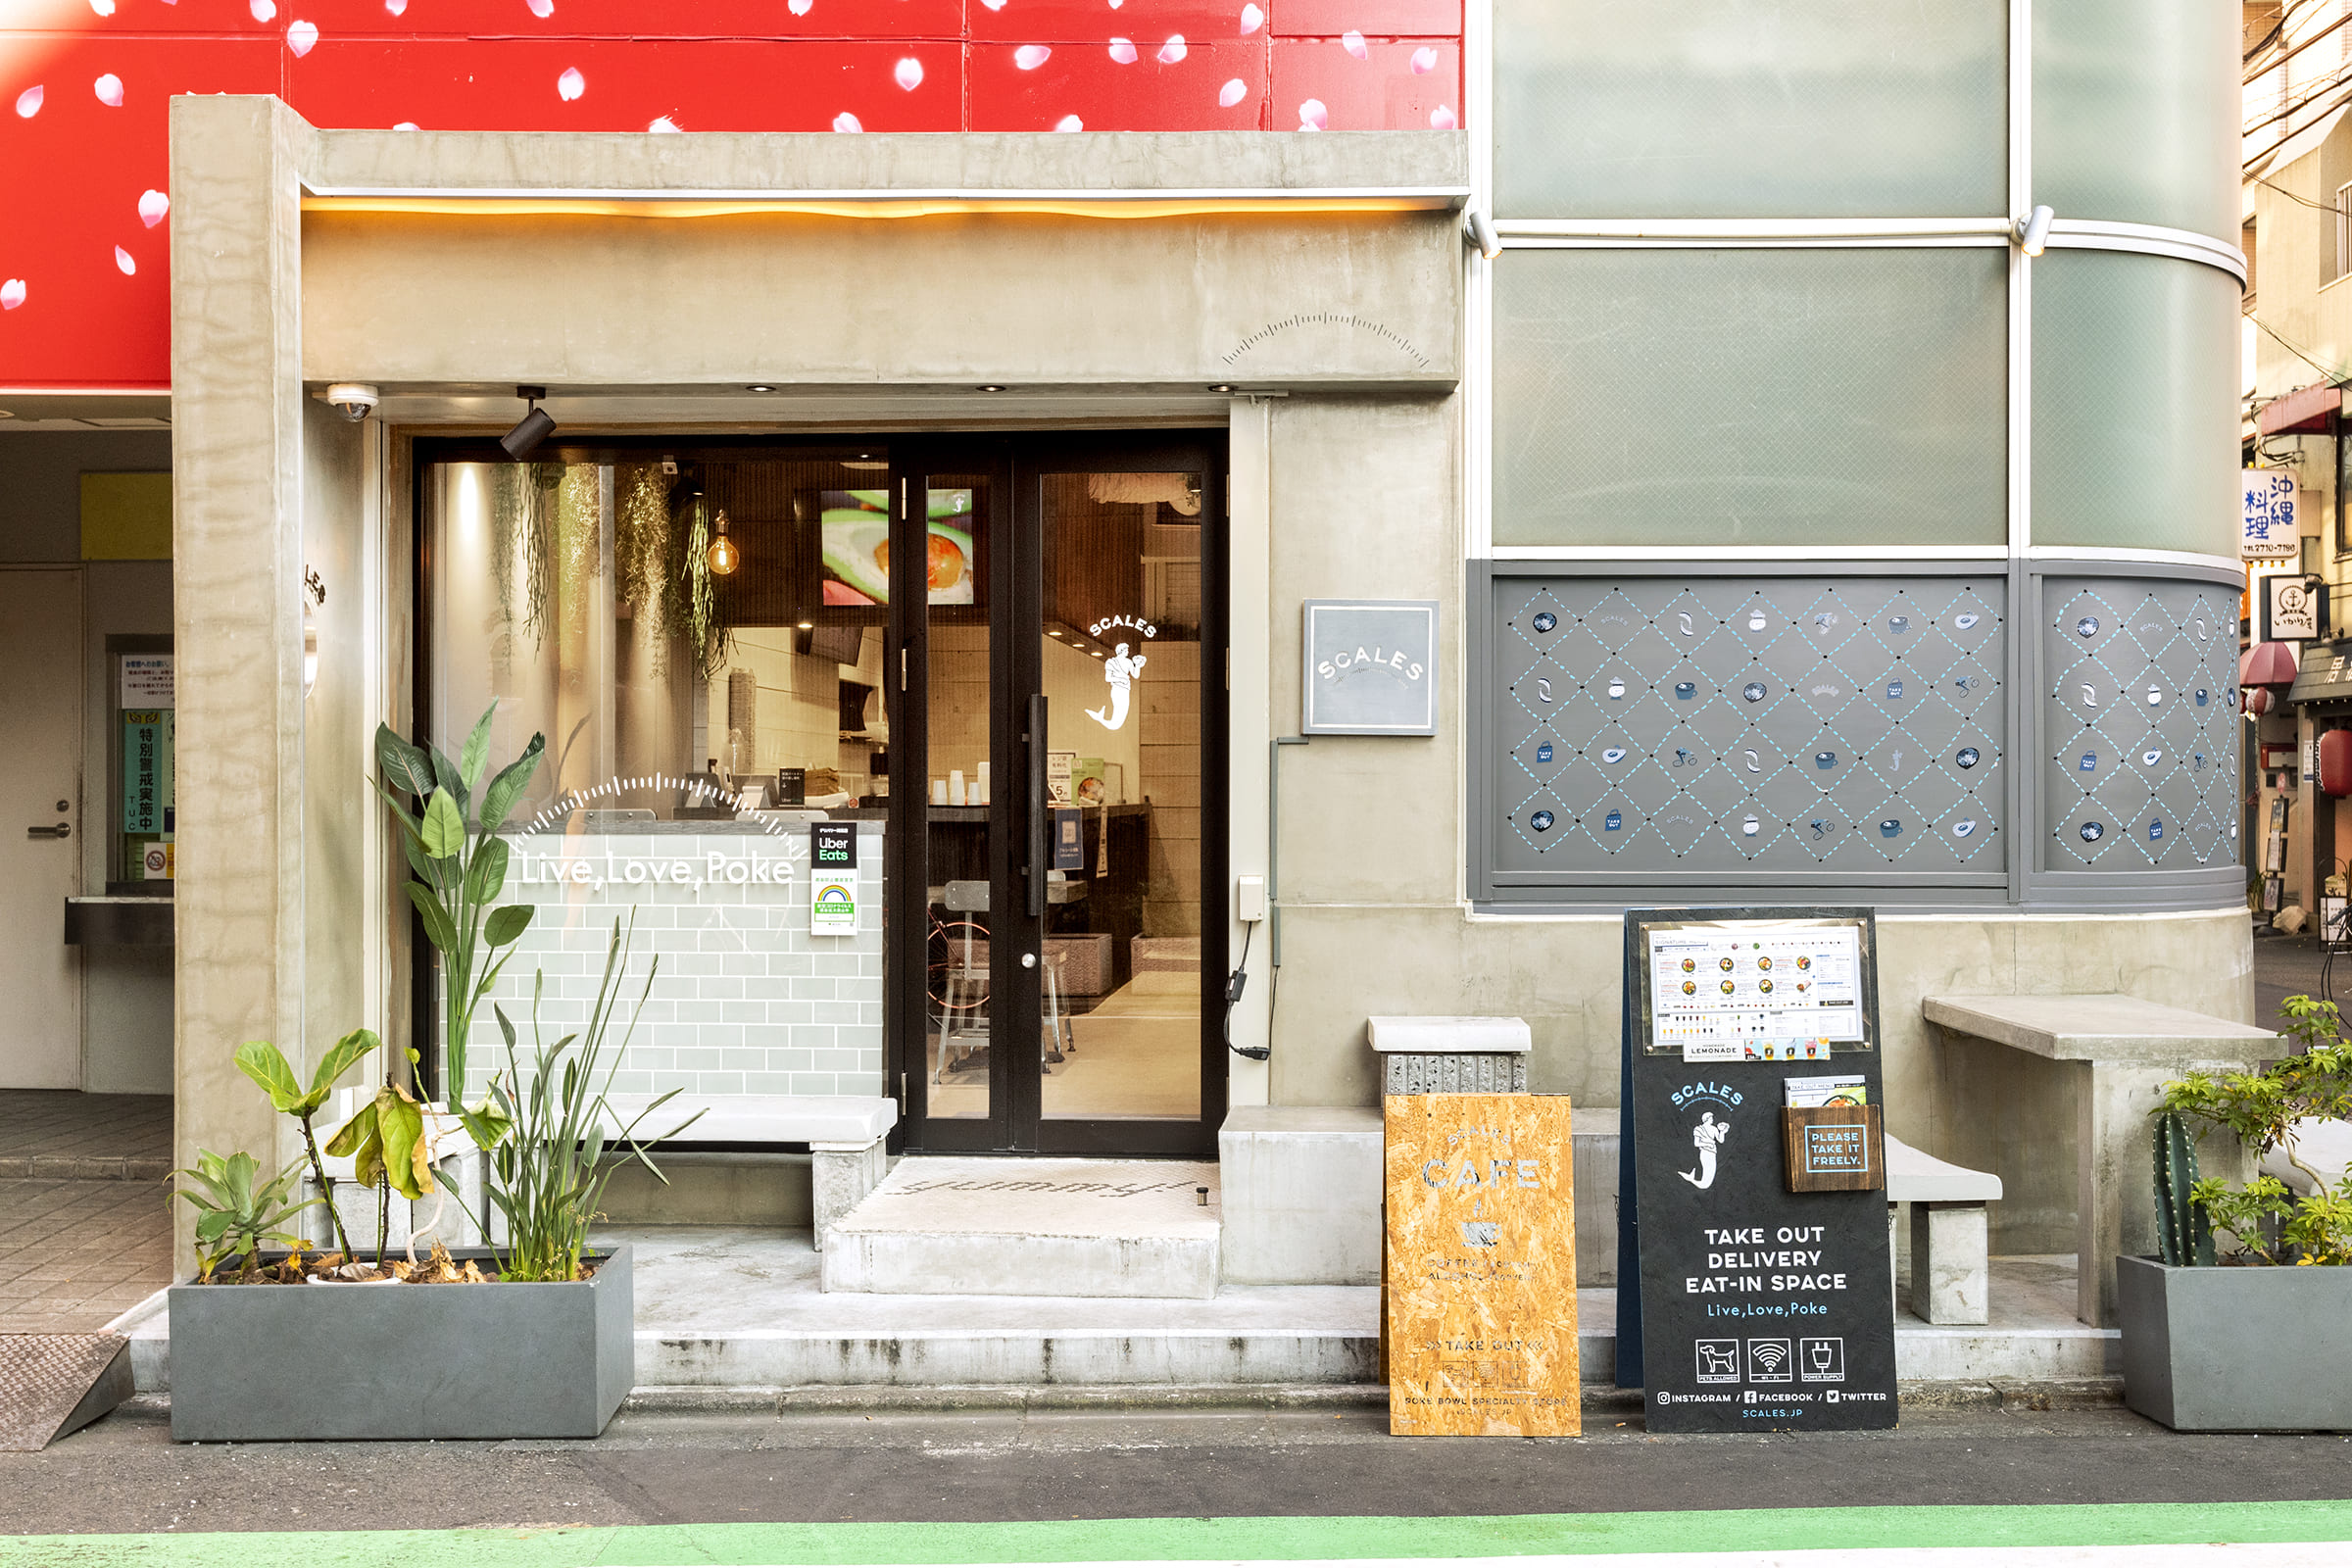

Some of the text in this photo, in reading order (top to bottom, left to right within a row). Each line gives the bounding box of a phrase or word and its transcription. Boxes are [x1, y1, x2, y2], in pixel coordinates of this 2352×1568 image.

[2270, 474, 2294, 526] 沖縄
[2244, 489, 2270, 540] 料理
[1089, 614, 1157, 638] SCALES
[2139, 621, 2164, 633] SCALES
[1317, 645, 1424, 681] SCALES
[139, 727, 154, 831] 特別警戒実施中
[1666, 814, 1694, 826] SCALES
[818, 837, 849, 850] Uber
[818, 849, 849, 861] Eats
[521, 850, 796, 892] Live,Love,Poke
[1670, 1081, 1744, 1106] SCALES
[1447, 1124, 1511, 1146] SCALES
[1811, 1132, 1859, 1143] PLEASE
[1811, 1144, 1860, 1154] TAKE IT
[1812, 1155, 1861, 1166] FREELY.
[1422, 1158, 1541, 1189] CAFE
[1704, 1226, 1826, 1245] TAKE OUT
[1427, 1258, 1479, 1268] COFFEE
[1708, 1250, 1823, 1269] DELIVERY
[1428, 1272, 1485, 1281] ALCOHOL
[1686, 1274, 1847, 1294] EAT-IN SPACE
[1707, 1301, 1828, 1319] Live,Love,Poke
[1446, 1340, 1525, 1351] TAKE OUT
[1404, 1396, 1433, 1405] POKE
[1438, 1396, 1467, 1405] BOWL
[1472, 1396, 1528, 1405] SPECIALTY
[1671, 1394, 1732, 1403] INSTAGRAM
[1759, 1393, 1813, 1402] FACEBOOK
[1841, 1392, 1886, 1401] TWITTER
[1741, 1408, 1803, 1419] SCALES.JP
